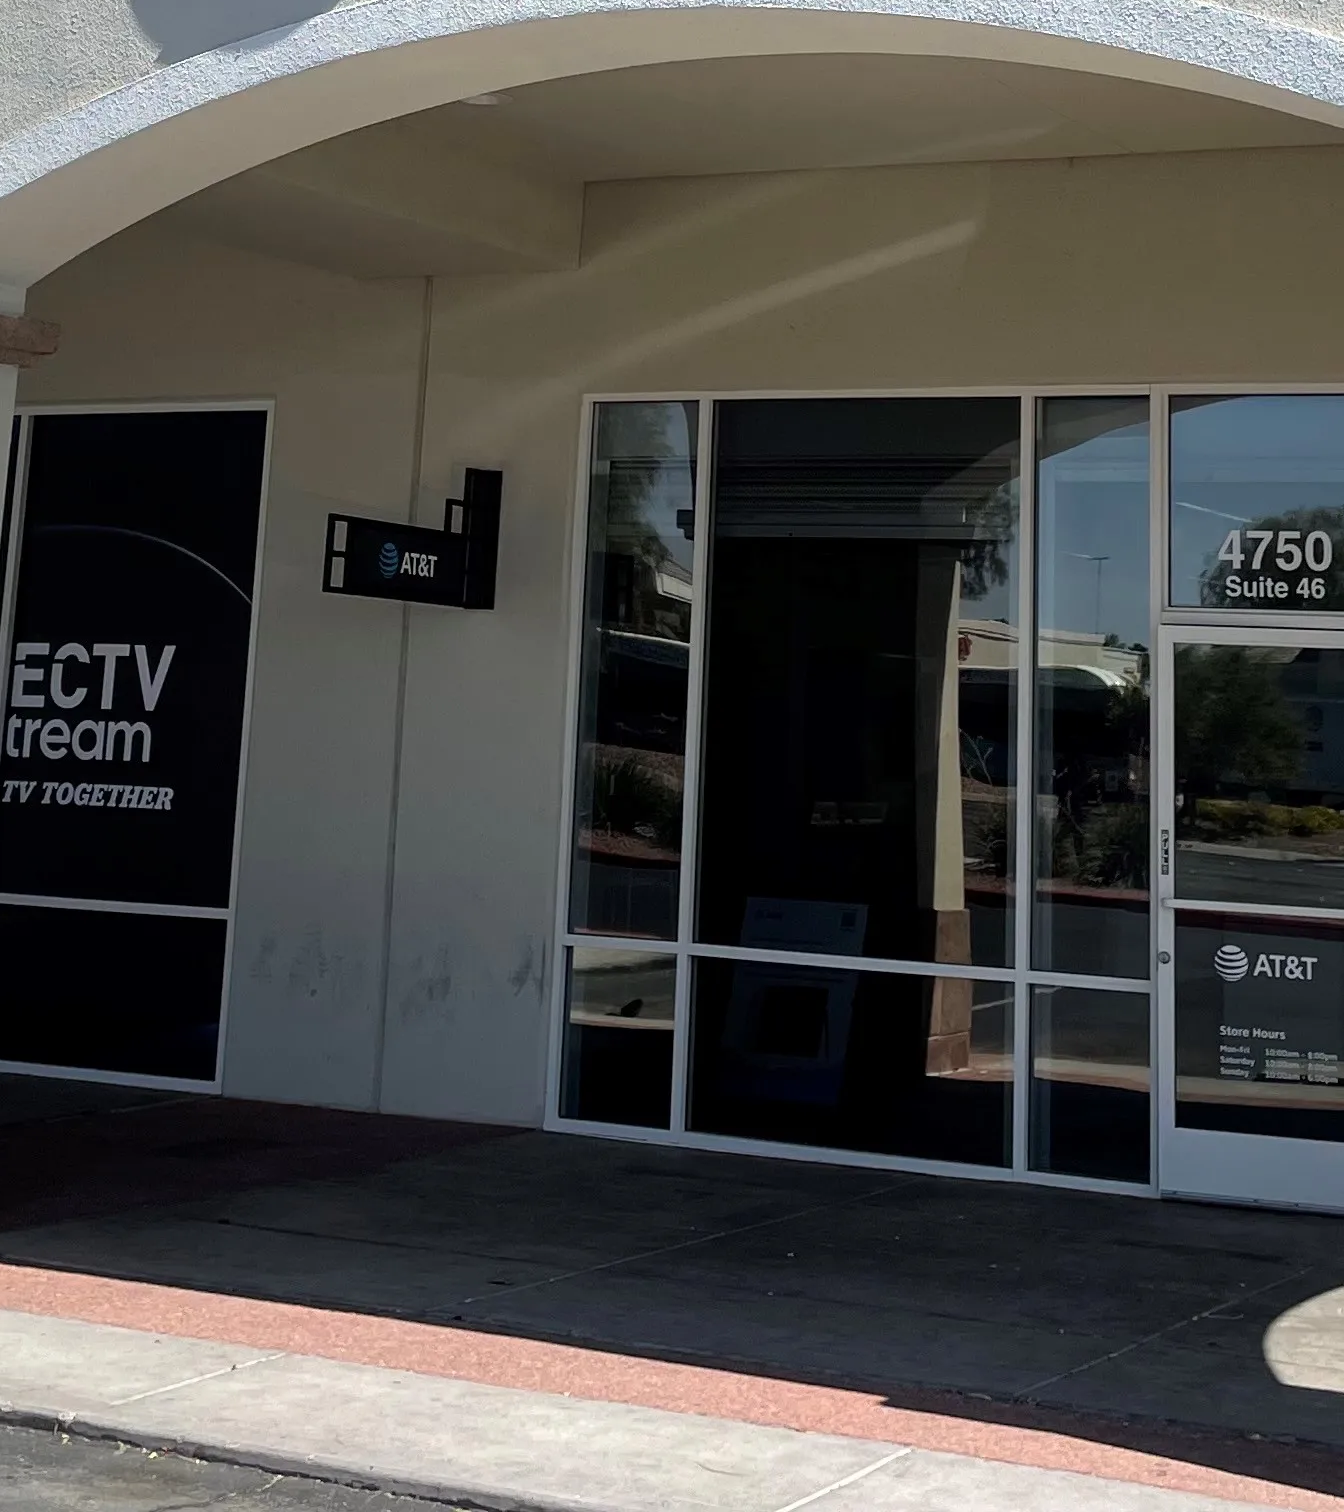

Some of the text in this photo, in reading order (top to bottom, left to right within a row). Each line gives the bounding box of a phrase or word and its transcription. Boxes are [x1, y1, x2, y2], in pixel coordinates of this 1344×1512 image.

[1217, 529, 1333, 572] 4750
[400, 551, 438, 578] AT&T
[1225, 575, 1326, 600] Suite 46
[2, 779, 37, 803] TV
[40, 781, 175, 811] TOGETHER
[1253, 954, 1318, 980] AT&T
[1219, 1025, 1286, 1040] Store Hours
